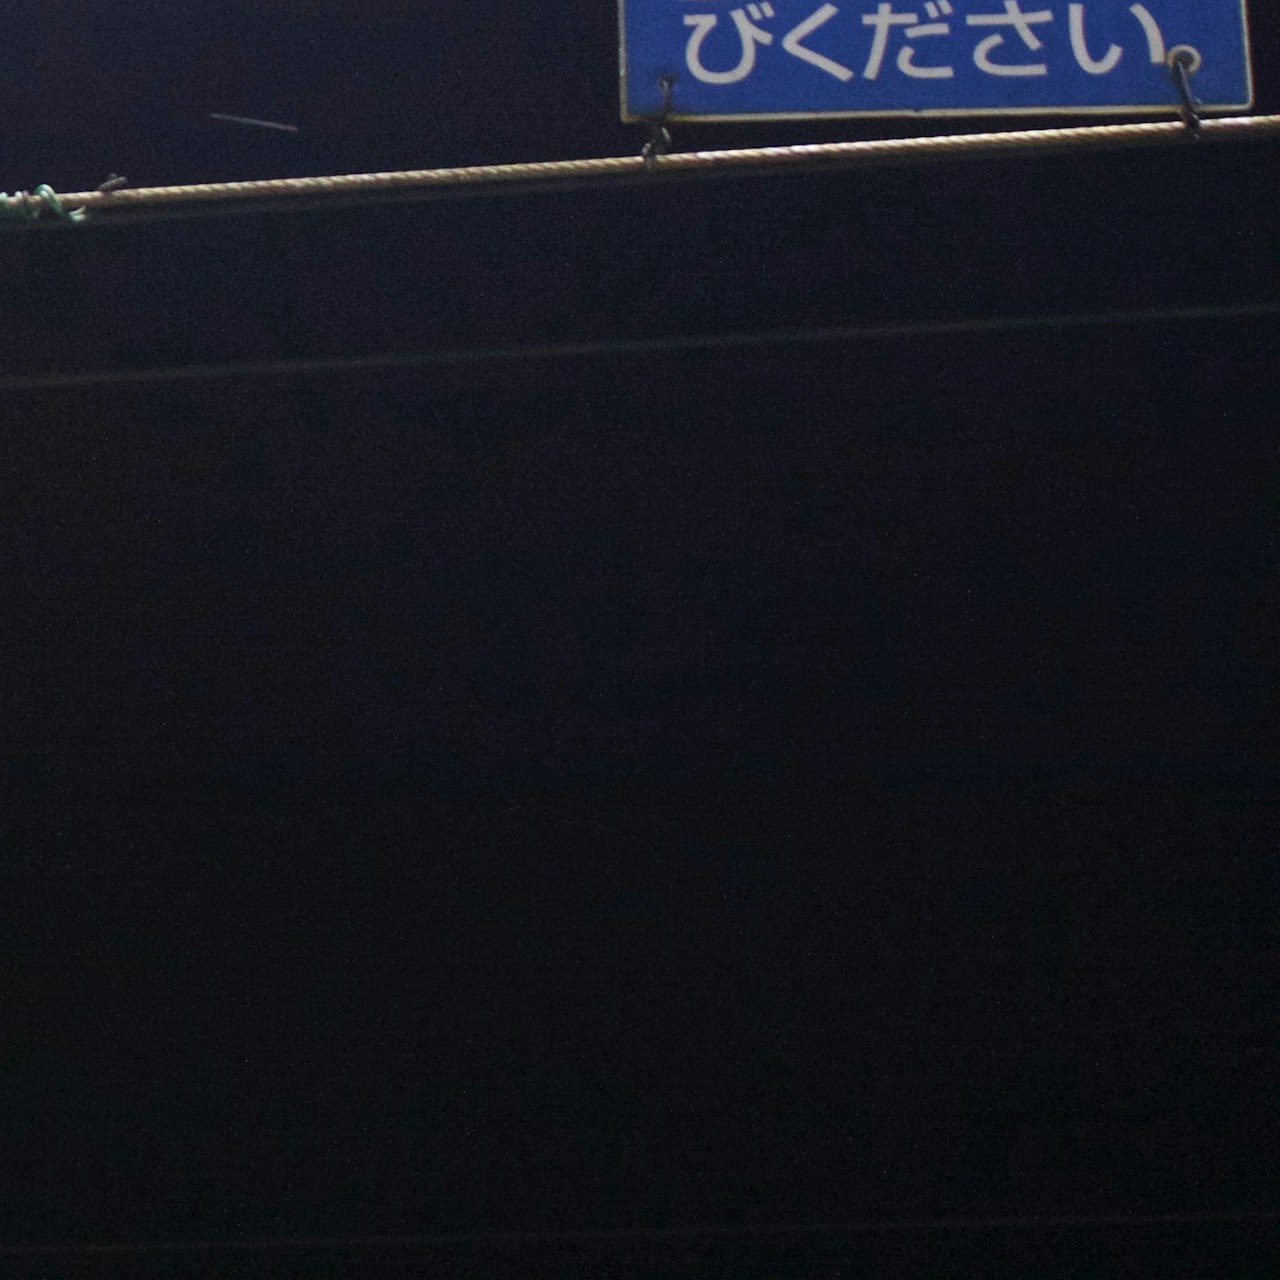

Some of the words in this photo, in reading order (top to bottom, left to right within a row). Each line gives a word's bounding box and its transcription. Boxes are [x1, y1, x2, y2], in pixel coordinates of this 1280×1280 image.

[683, 1, 1164, 86] びください
